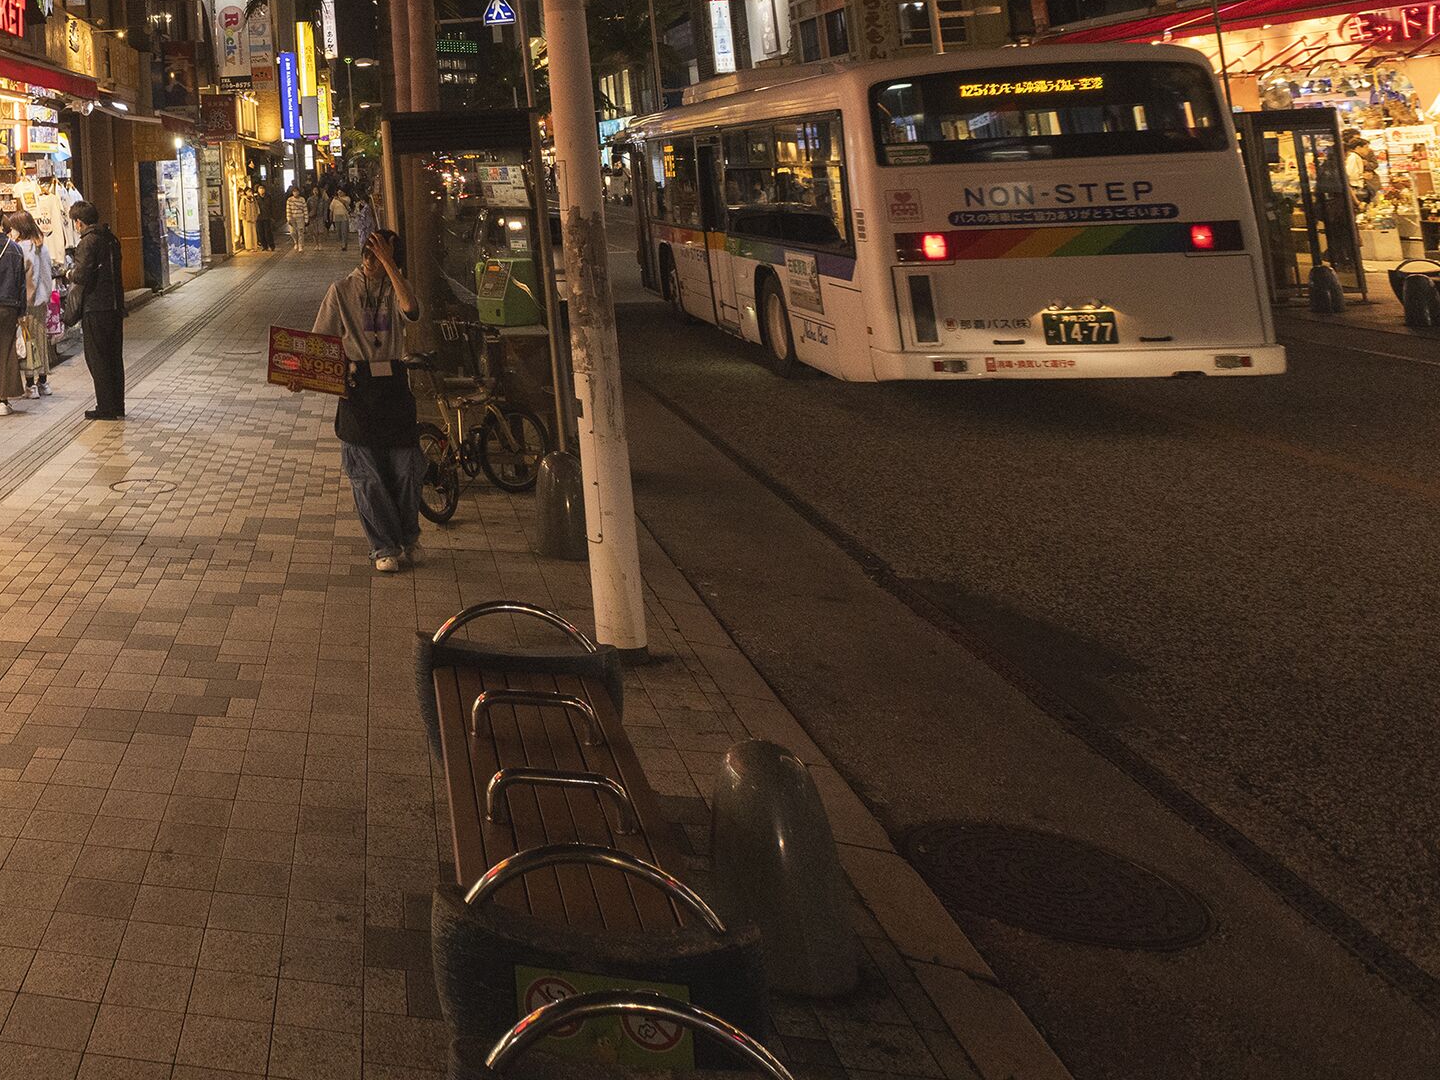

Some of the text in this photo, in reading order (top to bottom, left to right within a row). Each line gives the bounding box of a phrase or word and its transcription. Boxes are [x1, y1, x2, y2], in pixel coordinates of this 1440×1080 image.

[963, 180, 1154, 207] NON-STEP
[272, 329, 340, 358] 全国発送
[1060, 322, 1114, 343] 14-77
[302, 357, 345, 377] ¥950
